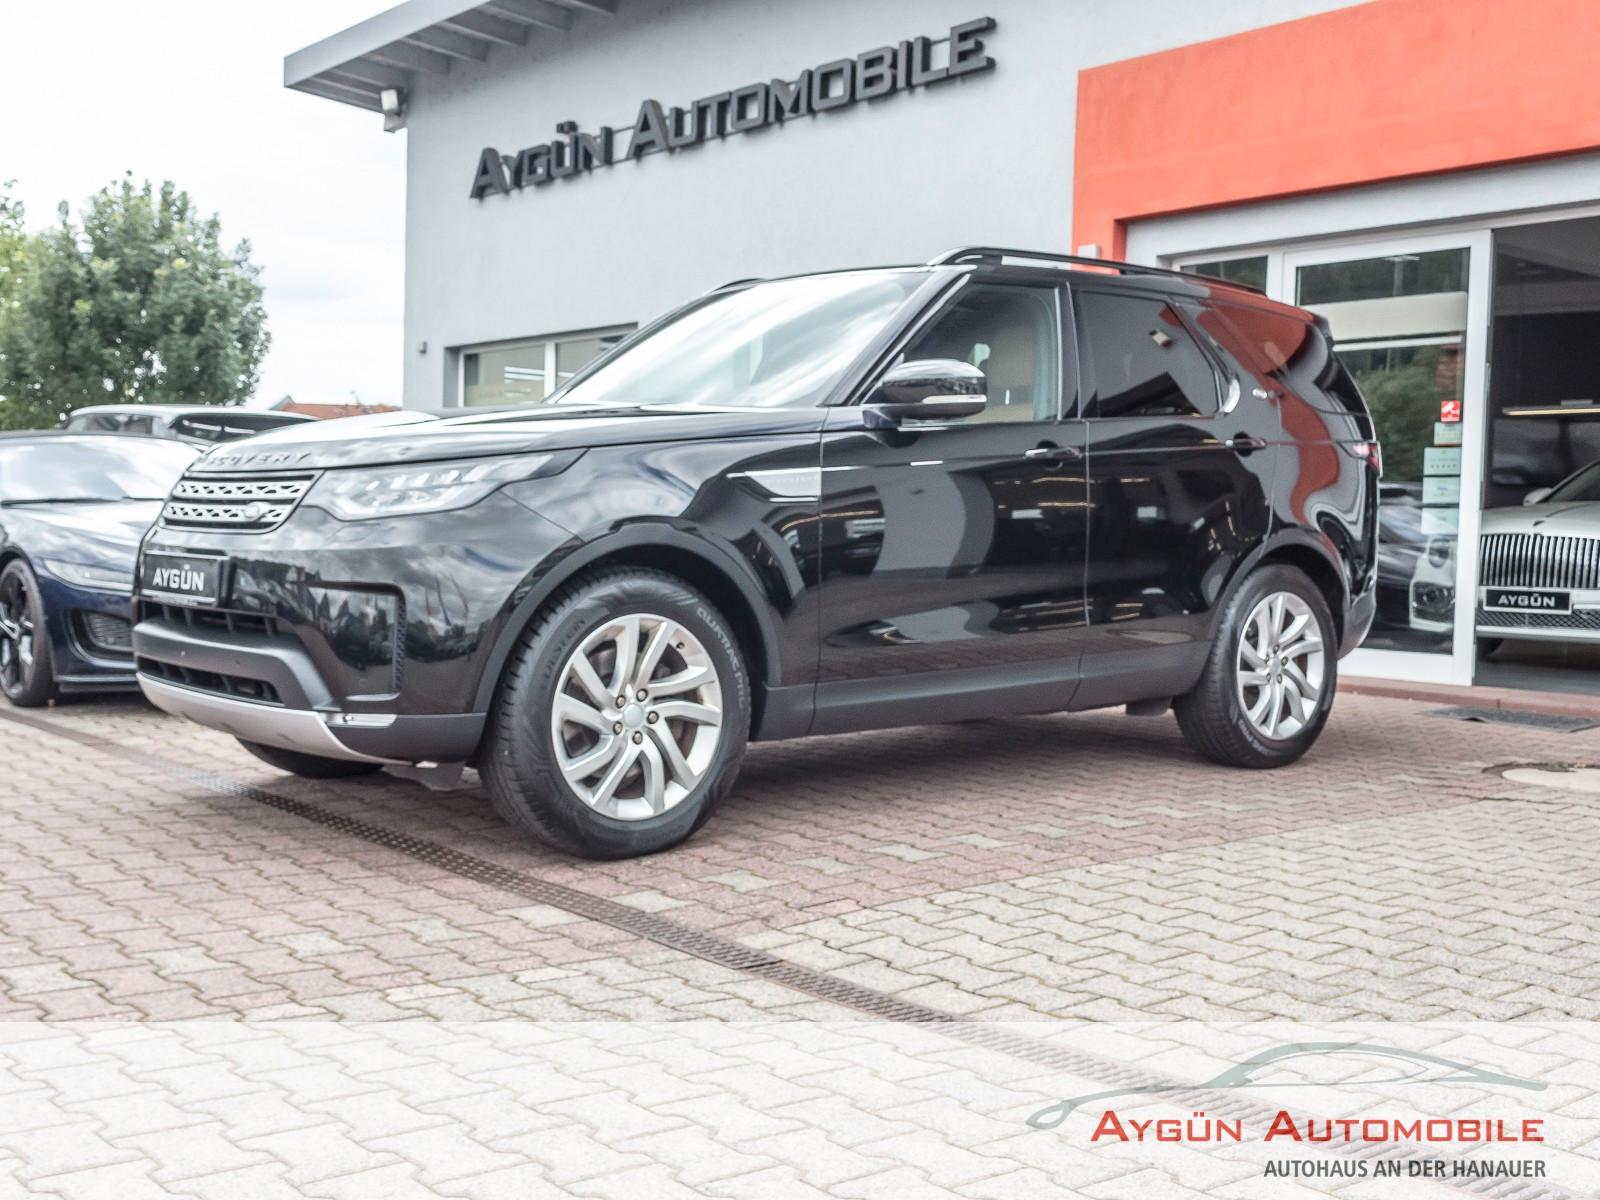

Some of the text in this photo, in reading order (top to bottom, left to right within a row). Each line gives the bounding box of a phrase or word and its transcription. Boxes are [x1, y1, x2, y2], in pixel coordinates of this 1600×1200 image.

[470, 16, 997, 199] AYGÜN AUTOMOBILE
[152, 563, 205, 591] AYGÜN
[1498, 593, 1556, 607] AYGÜN
